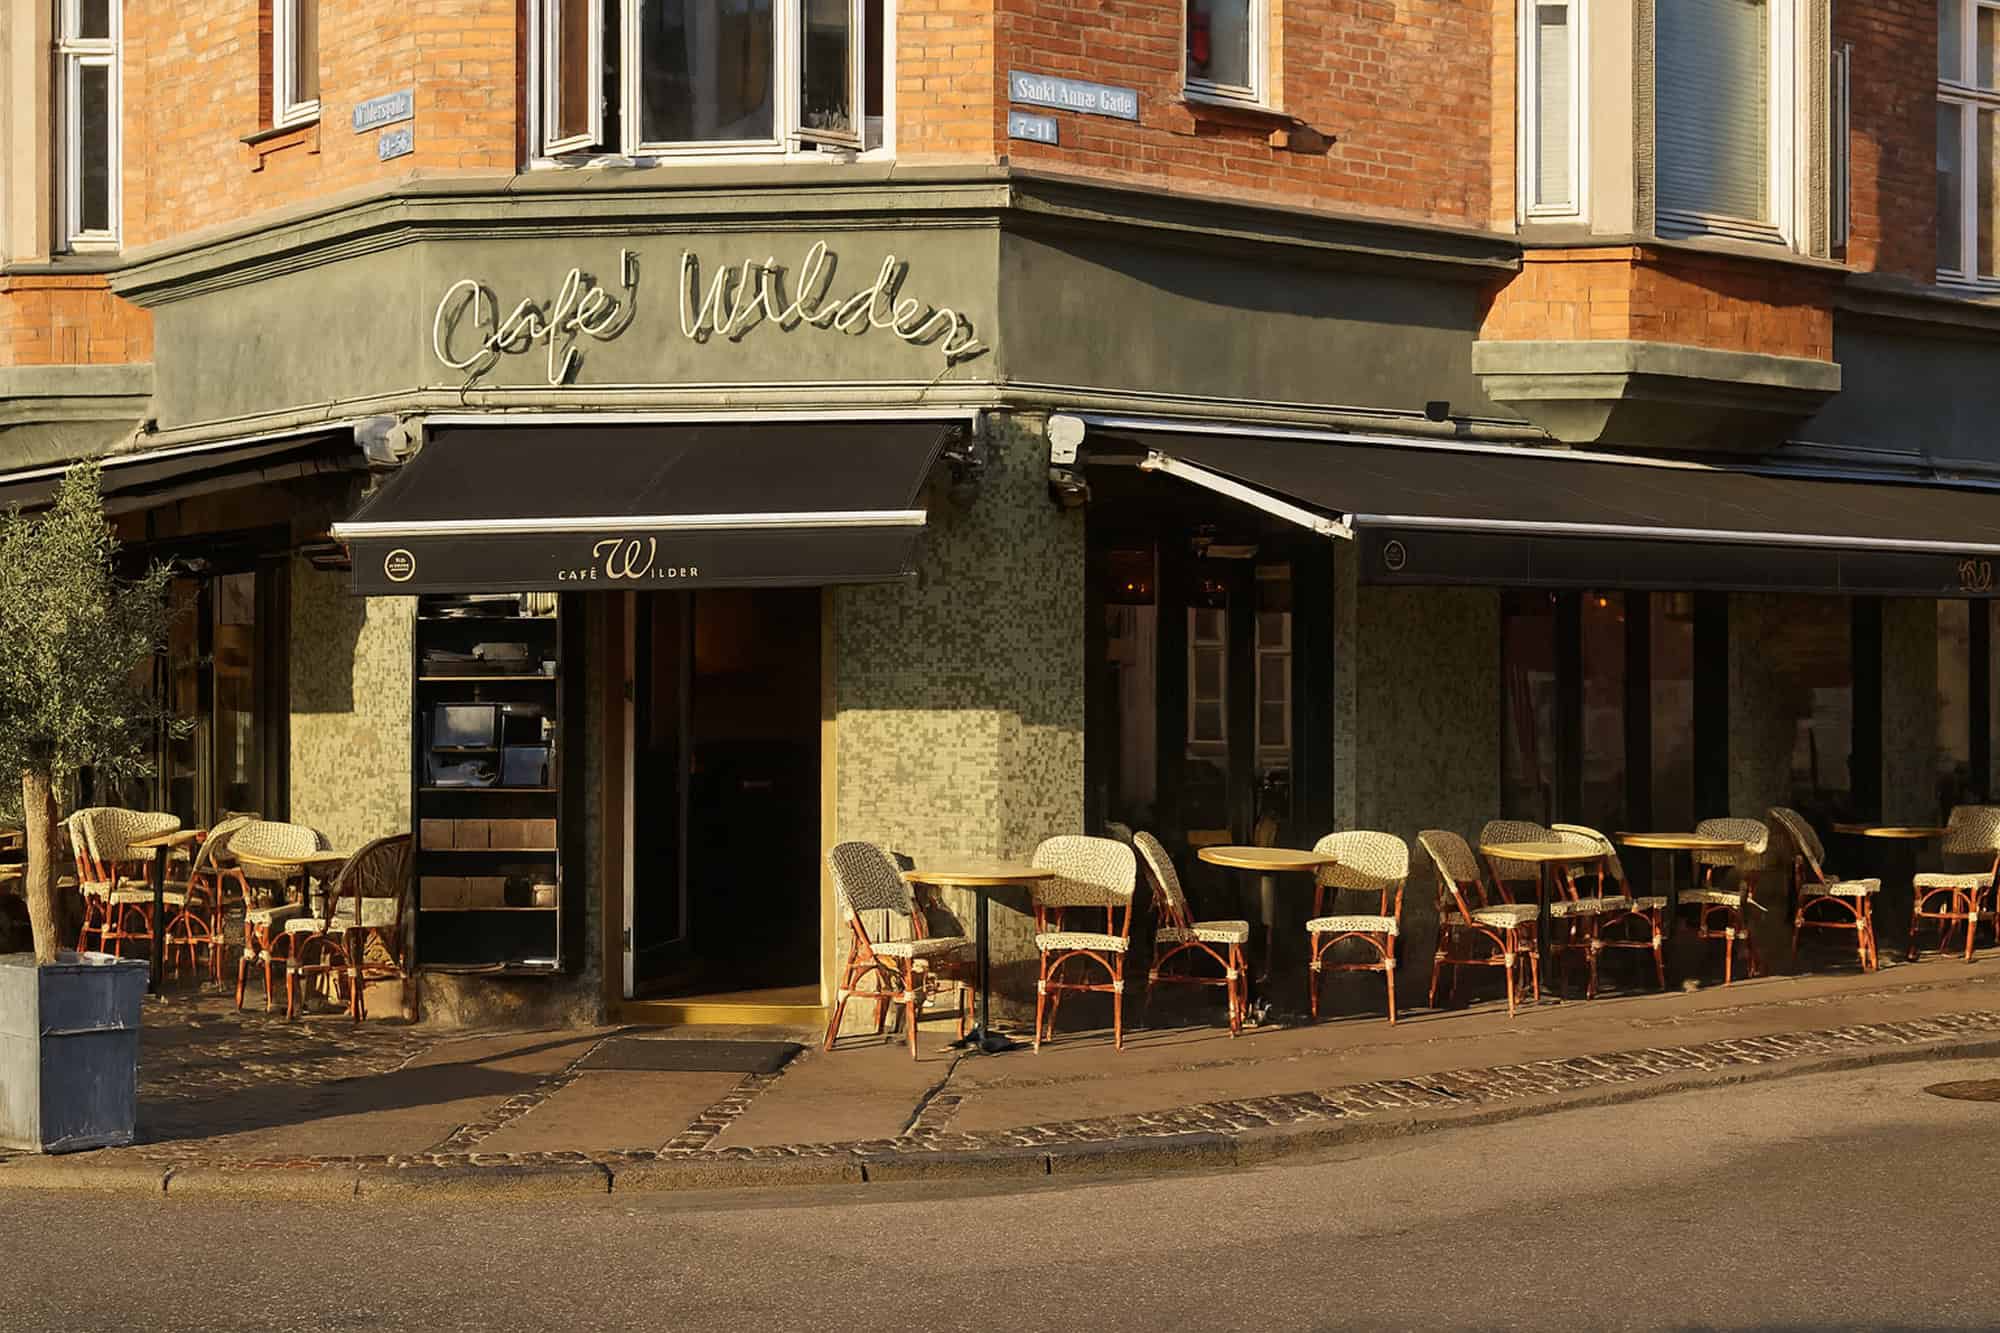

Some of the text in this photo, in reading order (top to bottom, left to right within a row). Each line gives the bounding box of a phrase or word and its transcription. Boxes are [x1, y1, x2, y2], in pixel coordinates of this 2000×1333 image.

[1018, 78, 1056, 103] Sankt
[1100, 90, 1133, 114] Gade
[679, 240, 979, 356] Wilder
[558, 566, 598, 581] CAFÉ
